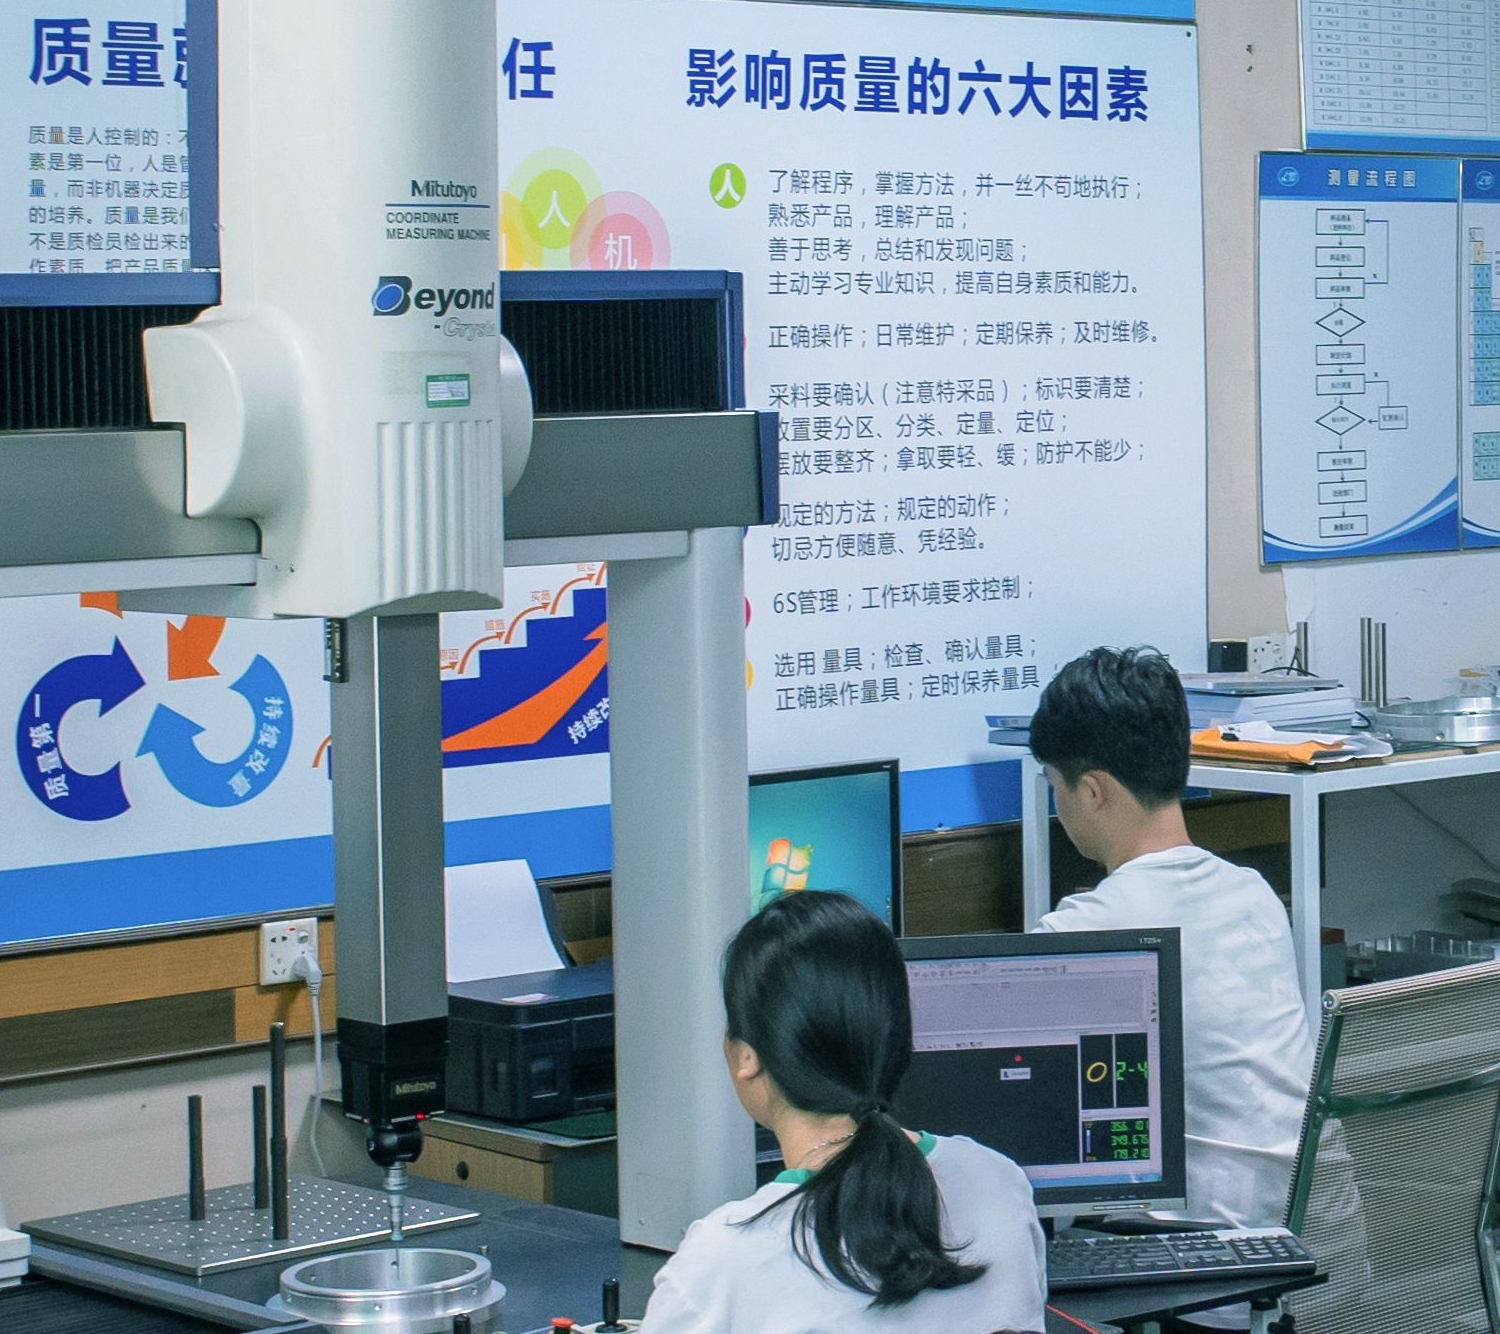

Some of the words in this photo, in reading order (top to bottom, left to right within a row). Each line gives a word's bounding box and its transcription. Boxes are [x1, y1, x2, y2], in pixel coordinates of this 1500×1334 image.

[685, 47, 1151, 124] 影响质量的六大因素
[1326, 168, 1417, 189] 测量流程图
[410, 179, 478, 203] Mitutoyo
[385, 212, 460, 225] COORDINATE
[385, 227, 456, 241] MEASURING
[457, 228, 491, 242] MACHINE
[372, 274, 496, 318] Beyond
